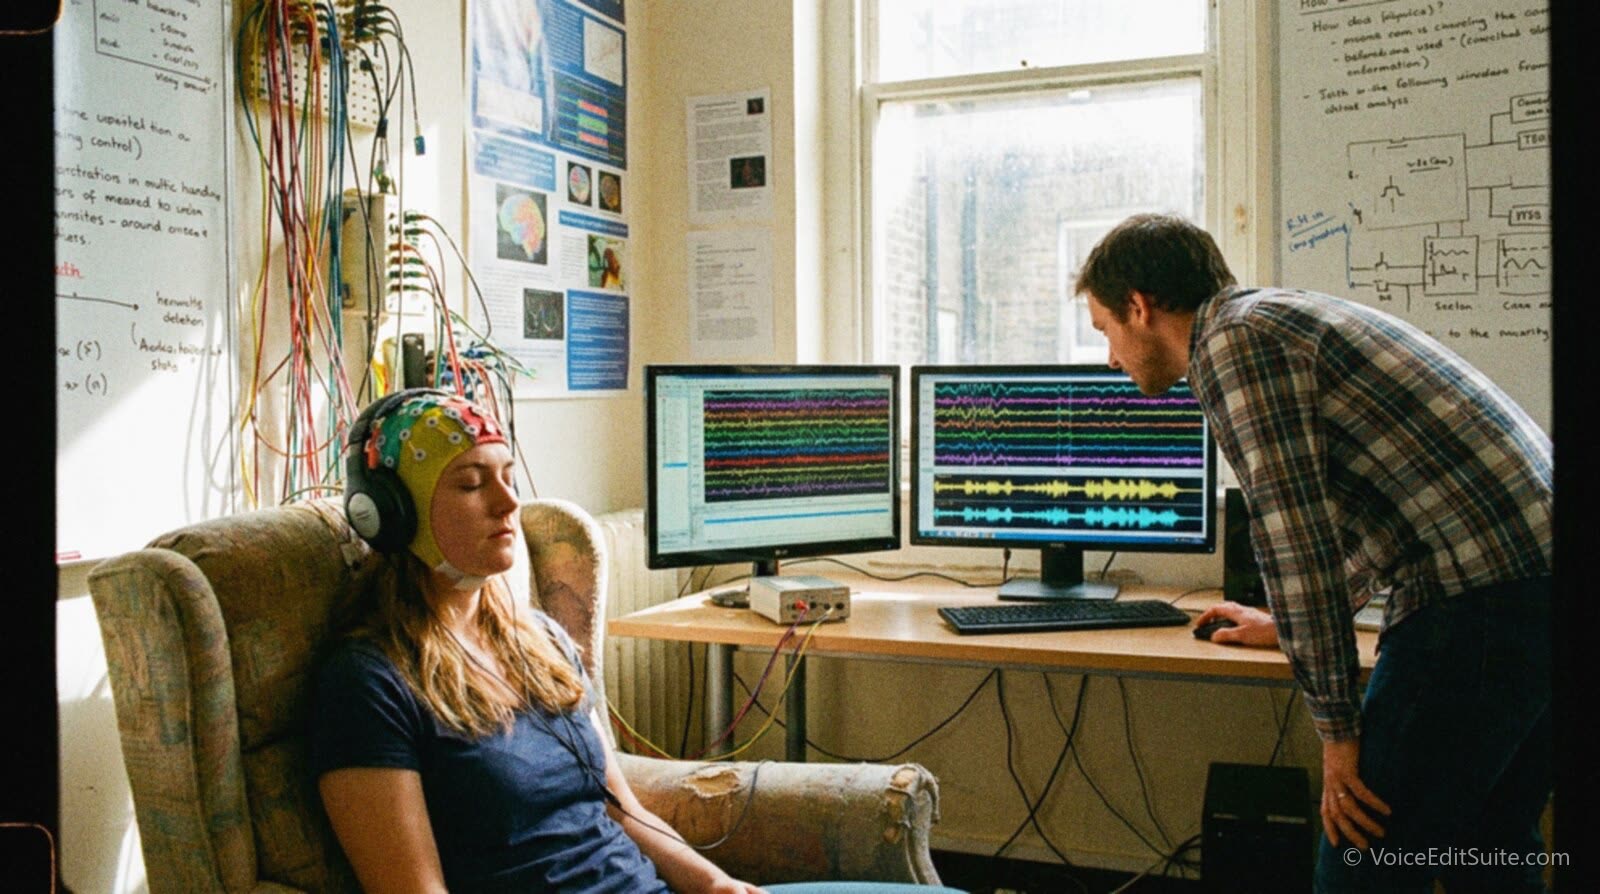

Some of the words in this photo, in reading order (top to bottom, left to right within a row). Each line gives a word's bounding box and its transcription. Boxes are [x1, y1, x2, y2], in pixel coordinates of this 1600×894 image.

[1495, 11, 1516, 20] the
[1312, 19, 1339, 32] How
[1416, 39, 1443, 50] used
[91, 135, 143, 161] control)
[128, 173, 140, 186] in
[83, 189, 97, 205] of
[158, 201, 171, 211] to
[121, 220, 162, 232] around
[1449, 329, 1461, 338] to
[1470, 327, 1490, 339] the
